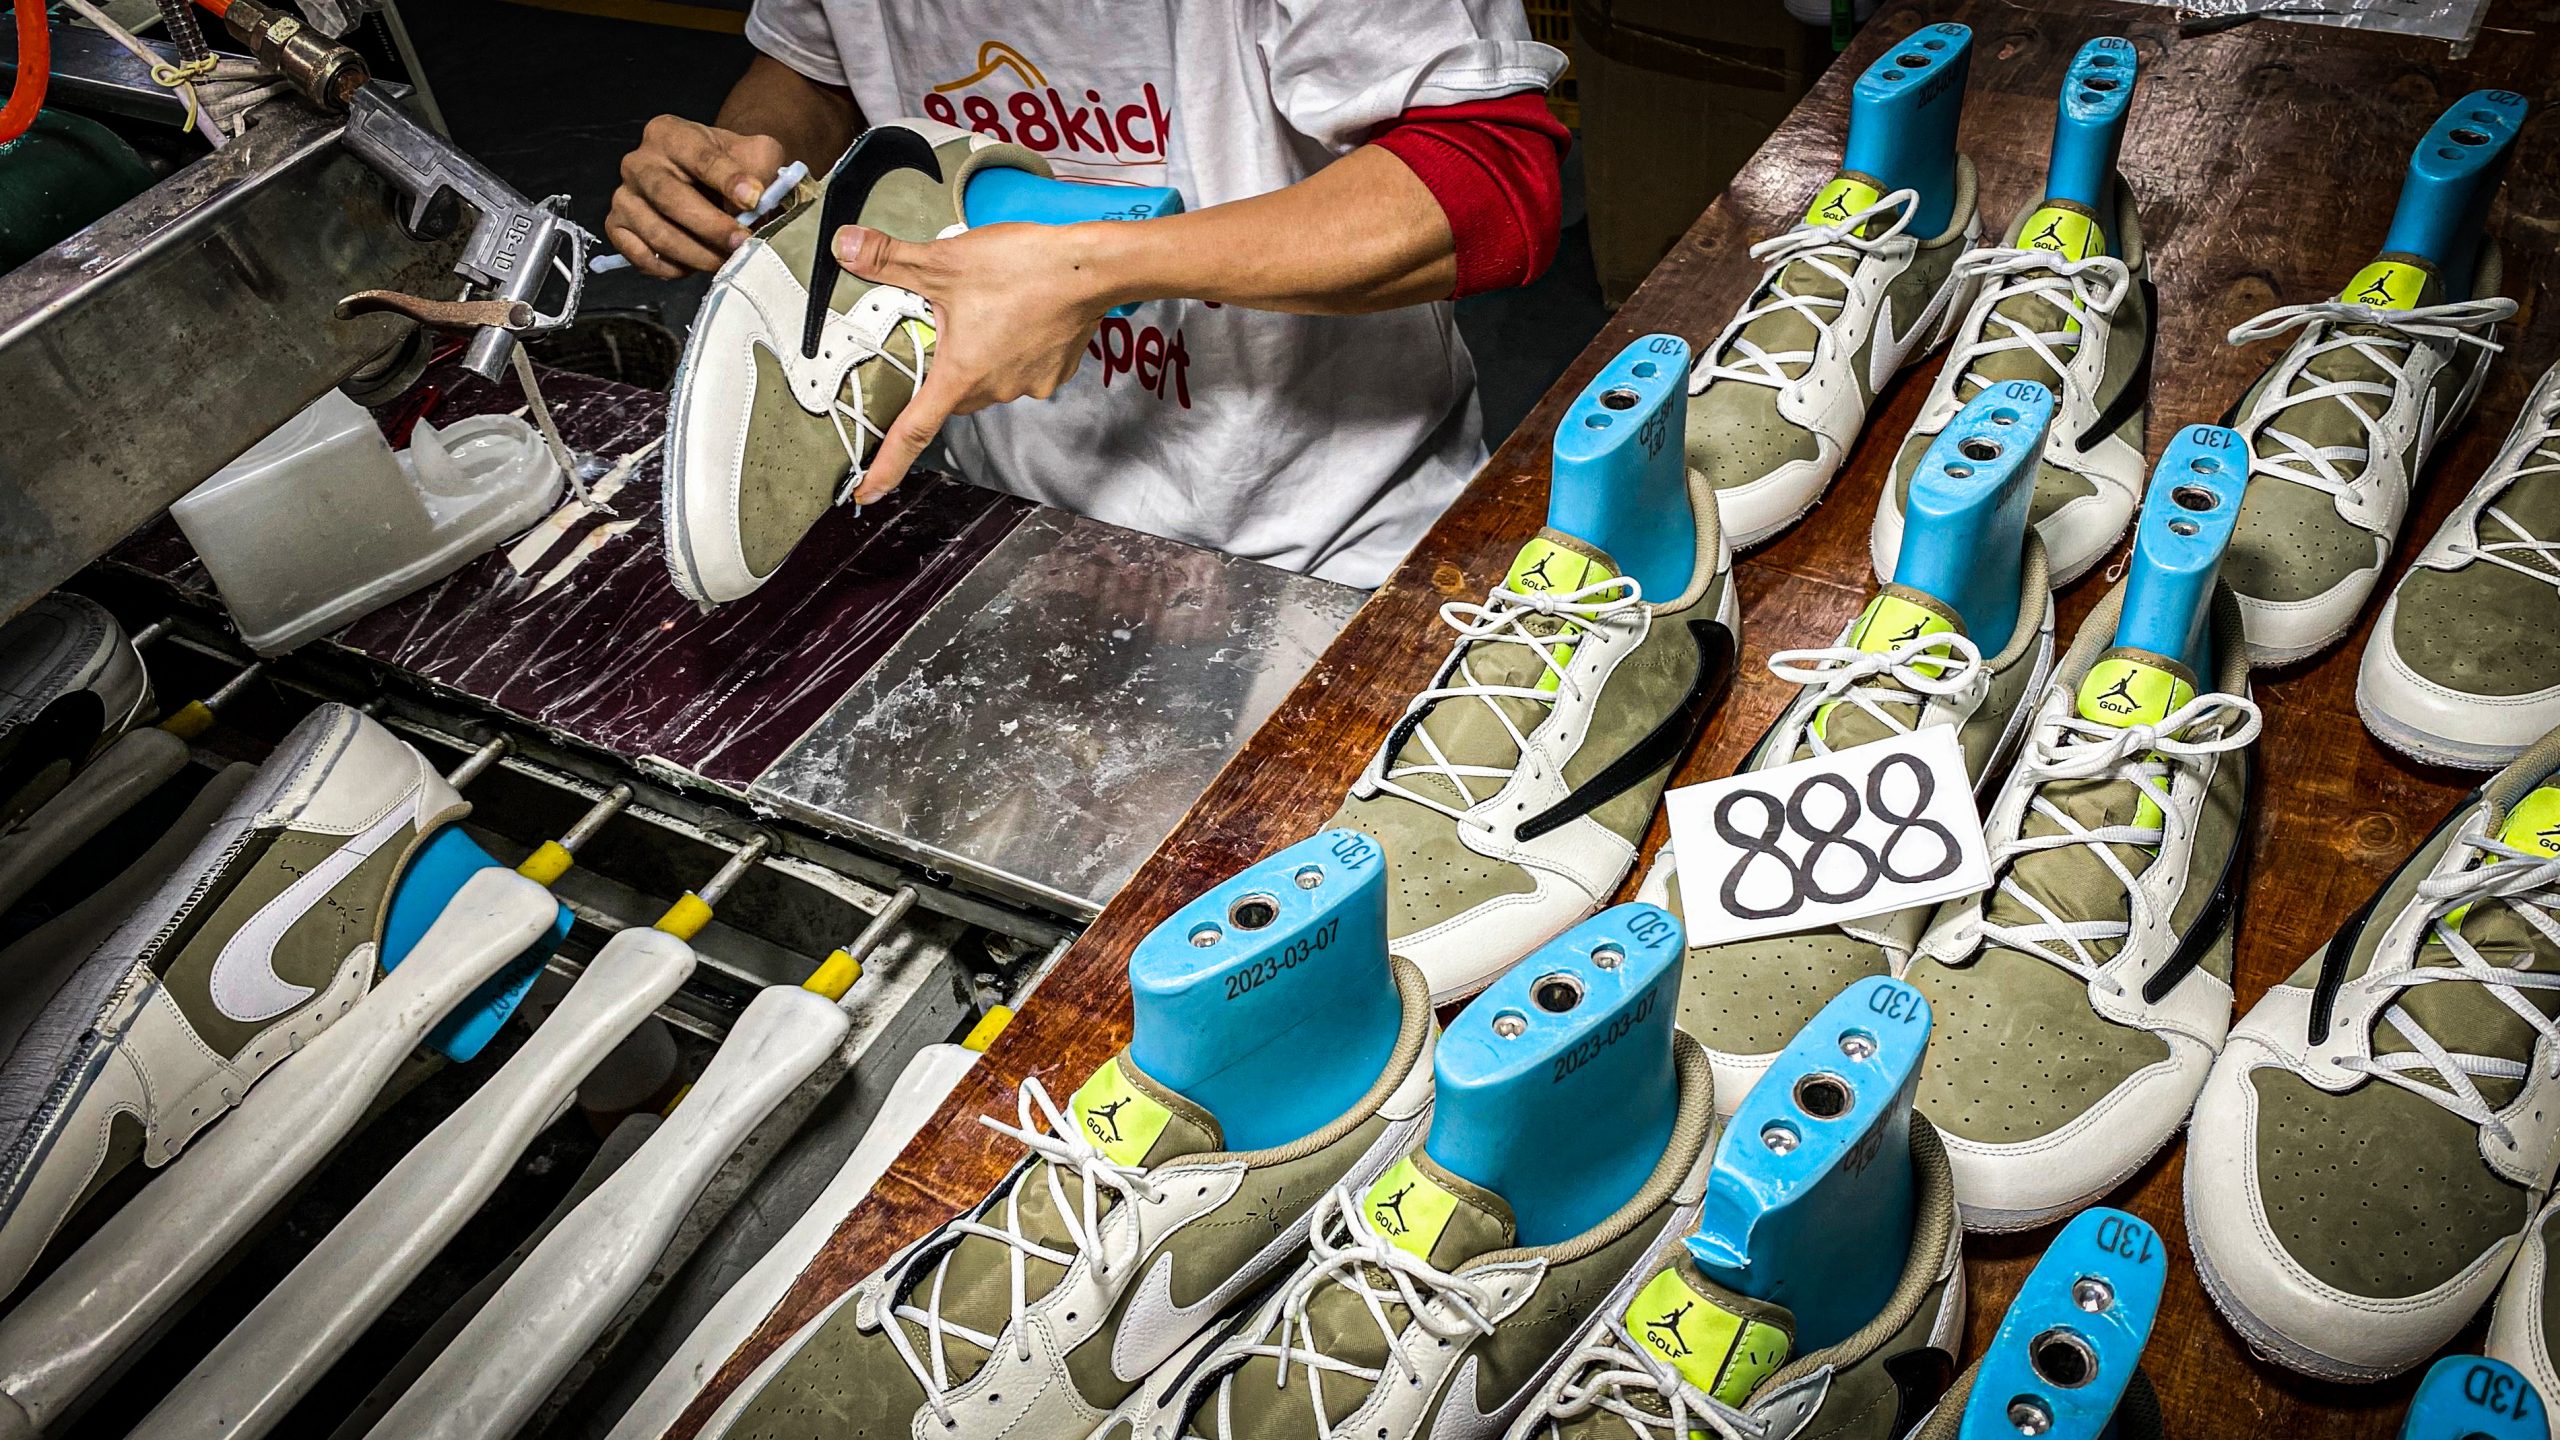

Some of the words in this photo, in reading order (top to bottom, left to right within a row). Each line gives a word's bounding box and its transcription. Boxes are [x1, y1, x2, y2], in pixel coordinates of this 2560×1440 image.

[2100, 37, 2129, 50] 13D
[1823, 211, 1847, 221] GOLF
[2034, 241, 2060, 251] GOLF
[2360, 296, 2388, 306] GOLF
[1649, 337, 1684, 356] 13D
[1088, 316, 1191, 409] pert
[2006, 382, 2044, 404] 13D
[2193, 427, 2232, 449] 13D
[2100, 700, 2134, 715] GOLF
[1713, 753, 1962, 919] 888
[1626, 911, 1676, 949] 13D
[1225, 917, 1340, 1000] 2023-03-07
[1869, 984, 1921, 1024] 13D
[1553, 986, 1658, 1084] 2023-03-07
[1086, 1117, 1114, 1143] GOLF
[1375, 1211, 1401, 1236] GOLF
[2097, 1216, 2154, 1264] 13D
[1647, 1330, 1683, 1358] GOLF
[2465, 1364, 2528, 1420] 13D
